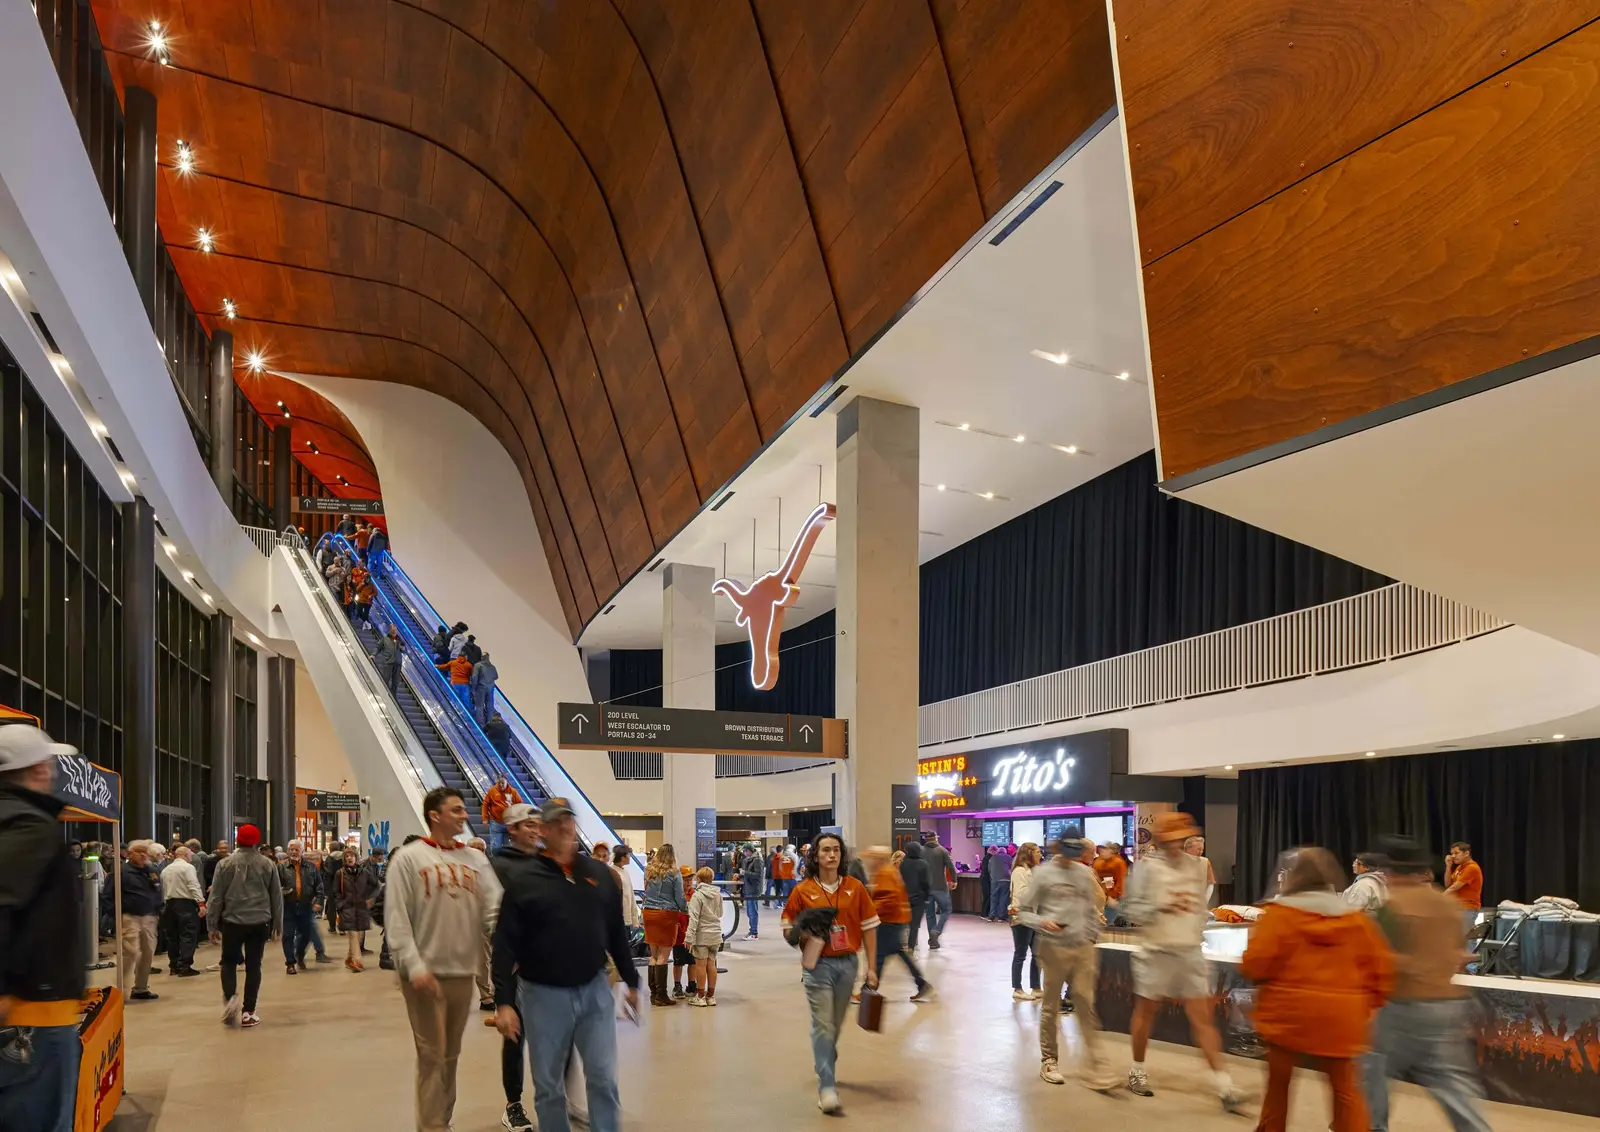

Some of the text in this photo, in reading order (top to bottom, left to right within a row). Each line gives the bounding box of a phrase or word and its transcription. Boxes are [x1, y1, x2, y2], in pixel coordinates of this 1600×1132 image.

[607, 711, 640, 720] 200 LEVEL
[626, 722, 662, 731] ESCALATOR
[724, 724, 784, 734] BROWN DISTRIBUTING
[607, 731, 636, 739] PORTALS
[741, 733, 784, 742] TEXAS TERRACE
[917, 756, 966, 776] STIN'S
[991, 748, 1076, 797] Tito's
[935, 797, 966, 808] VODKA
